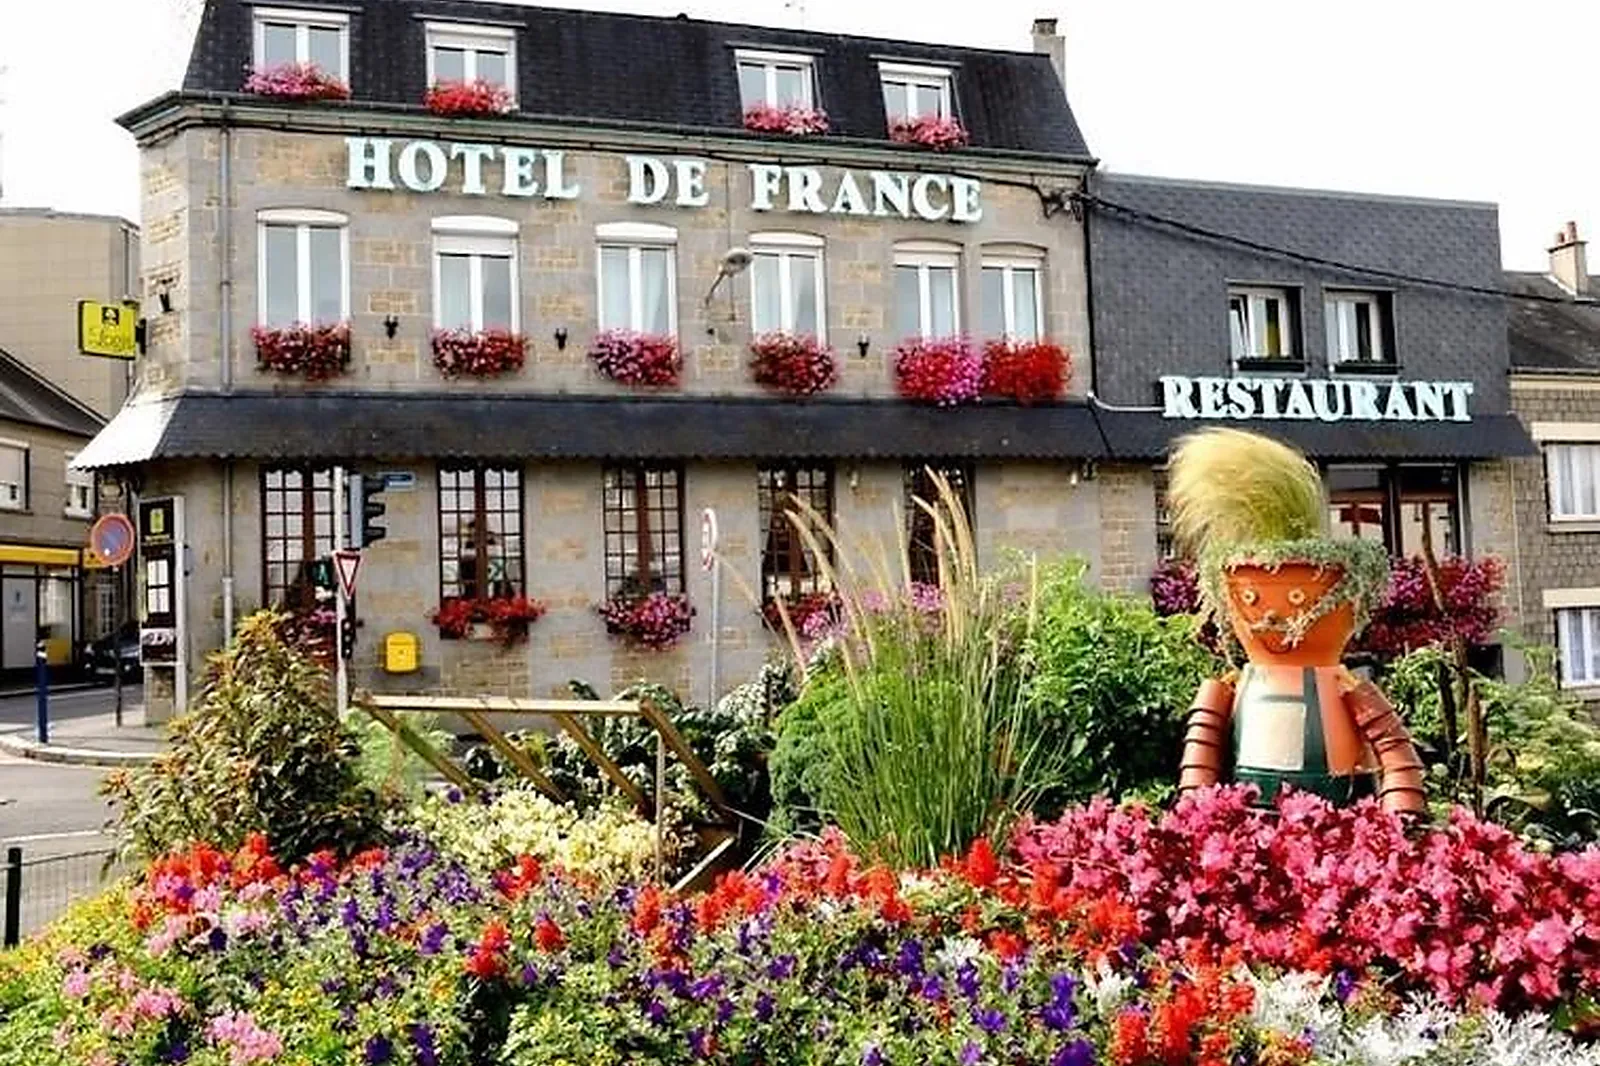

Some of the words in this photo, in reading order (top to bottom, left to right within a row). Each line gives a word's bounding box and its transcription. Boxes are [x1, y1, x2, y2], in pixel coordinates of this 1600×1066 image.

[345, 137, 580, 198] HOTEL
[626, 155, 710, 206] DE
[749, 163, 983, 222] FRANCE
[1160, 376, 1474, 421] RESTAURANT
